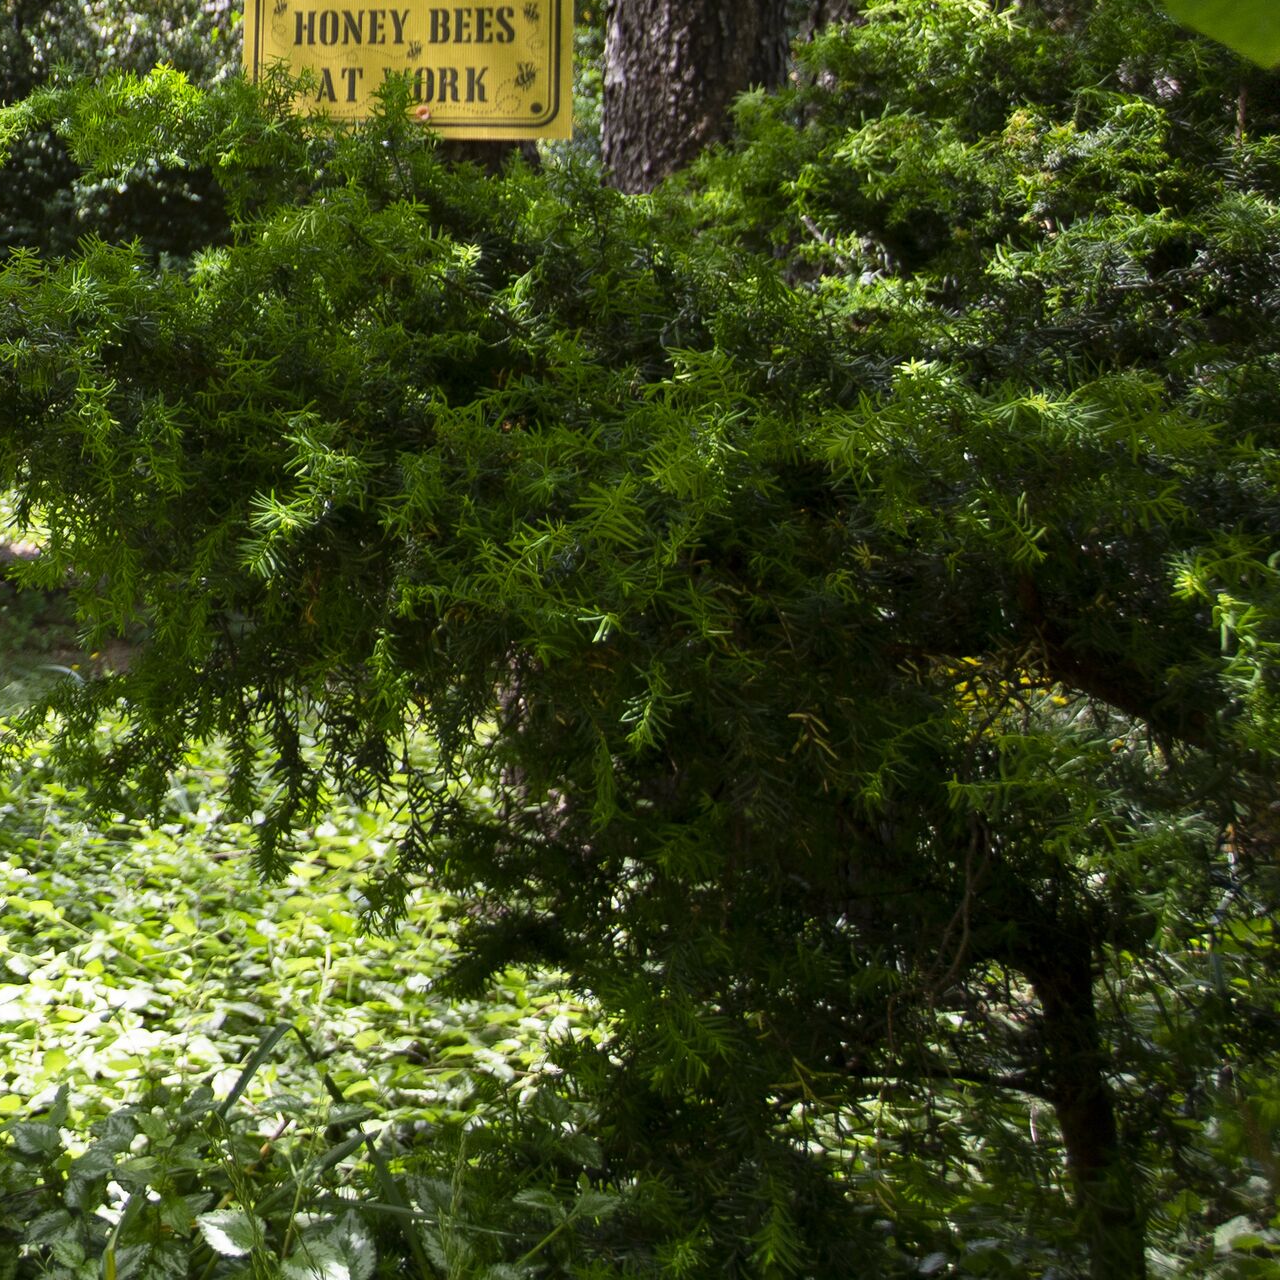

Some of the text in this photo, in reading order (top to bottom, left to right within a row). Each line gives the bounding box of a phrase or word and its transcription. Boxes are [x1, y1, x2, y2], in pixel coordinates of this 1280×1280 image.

[294, 7, 516, 46] HONEY BEES
[316, 66, 489, 103] AT ORK
